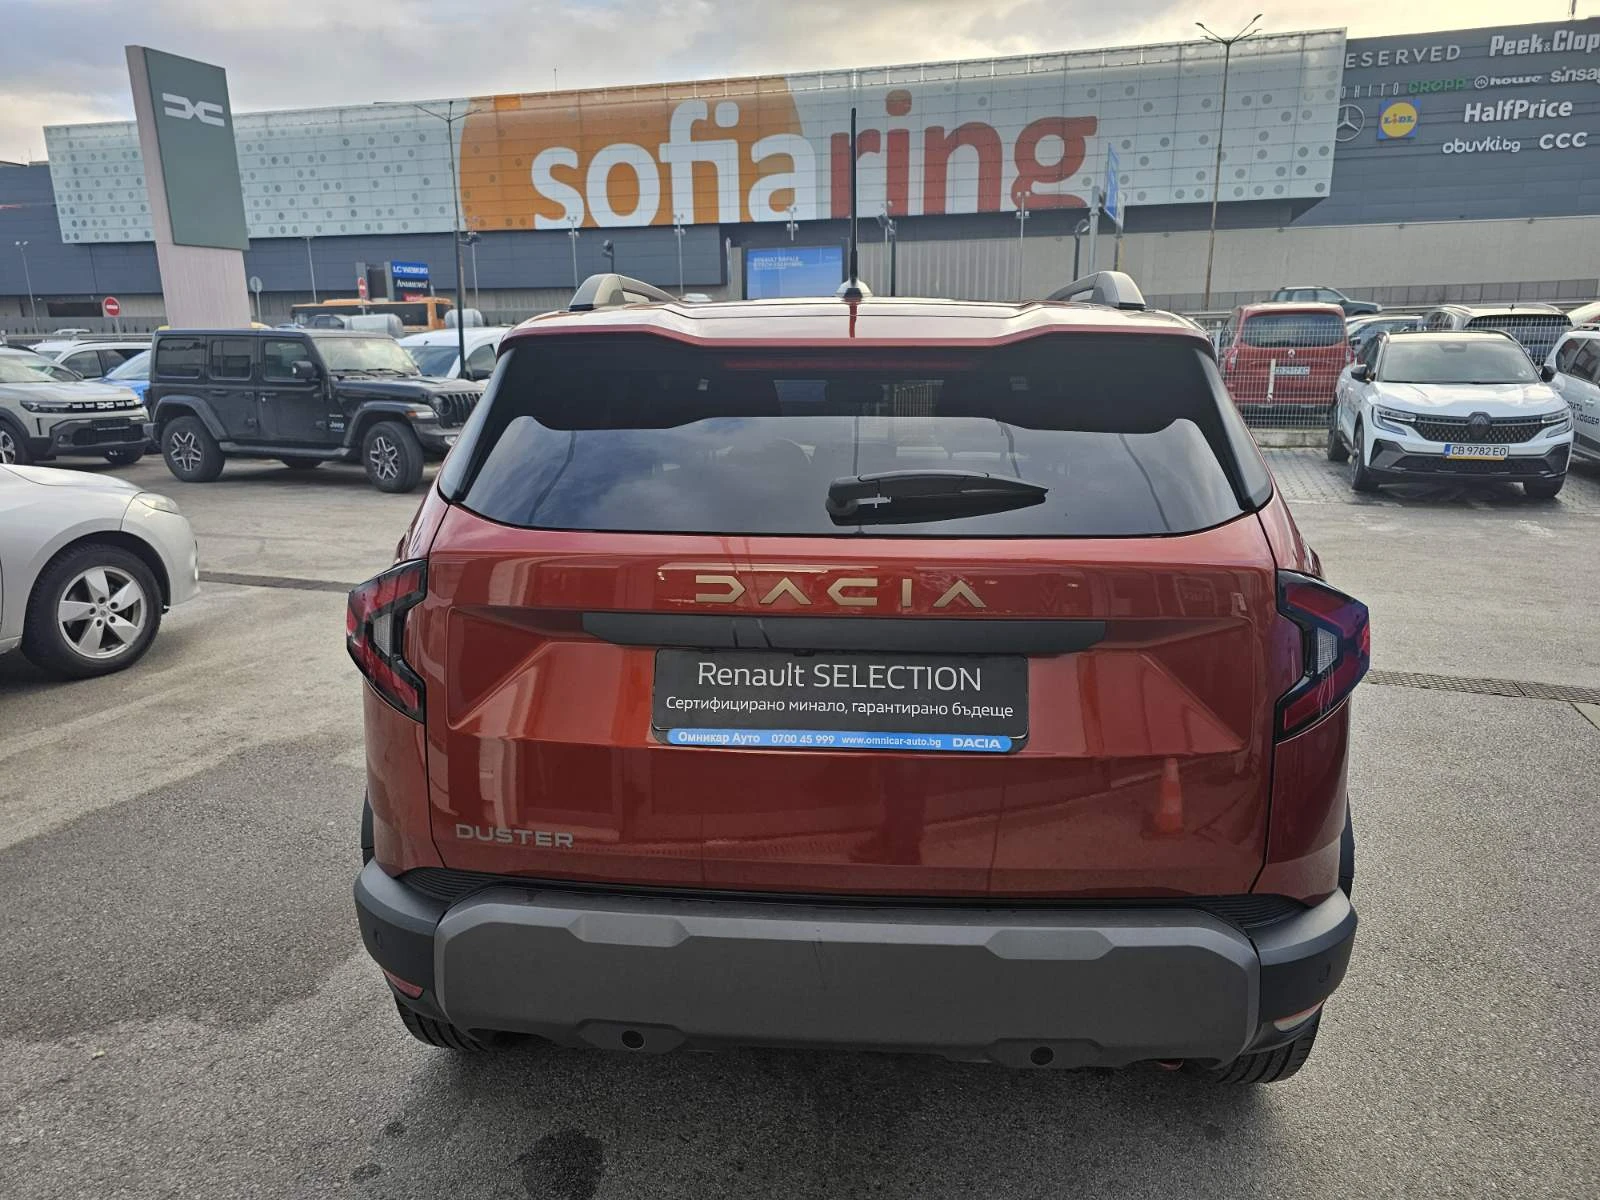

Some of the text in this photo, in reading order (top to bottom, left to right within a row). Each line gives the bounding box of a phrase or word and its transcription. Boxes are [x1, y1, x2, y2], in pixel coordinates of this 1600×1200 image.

[1464, 99, 1573, 123] HalfPrice
[1442, 135, 1521, 154] obuvki.bg
[1539, 131, 1588, 150] CCC
[1451, 446, 1465, 455] CB
[1467, 446, 1491, 456] 9782
[695, 574, 987, 608] DACIA
[697, 661, 982, 691] Renault SELECTION
[666, 696, 1013, 719] Сертифицирано минало, гарантирано бъдеще
[678, 731, 761, 745] Омникар Ауто
[771, 733, 835, 745] 0700 45 999
[842, 735, 942, 748] www.omnicar-auto.bg
[952, 737, 1001, 749] DACIA
[455, 823, 574, 848] DUSTER
